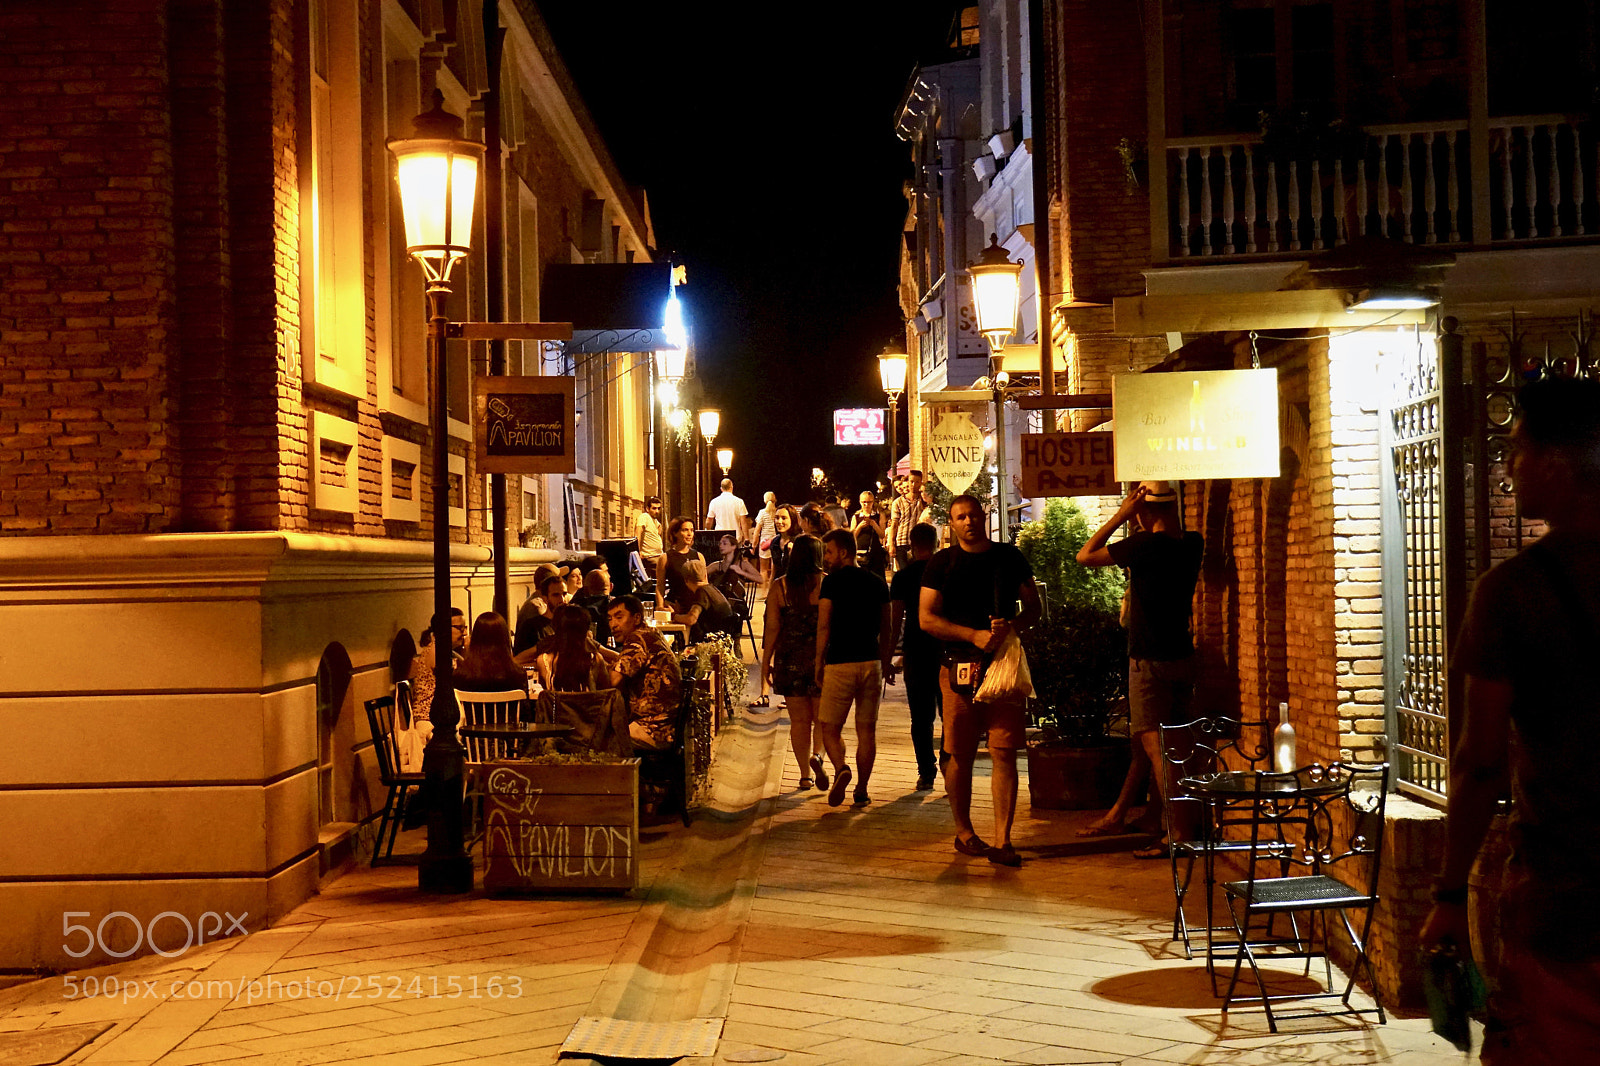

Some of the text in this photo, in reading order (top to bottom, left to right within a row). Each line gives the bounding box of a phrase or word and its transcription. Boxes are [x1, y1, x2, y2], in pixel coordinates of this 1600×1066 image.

[1142, 411, 1168, 426] Bar
[508, 431, 561, 446] PAVILION
[933, 433, 979, 442] TSANGALA'S
[930, 446, 981, 463] WINE
[941, 470, 974, 478] shop&bar
[493, 773, 519, 799] Cafe
[520, 819, 631, 878] PAVILION
